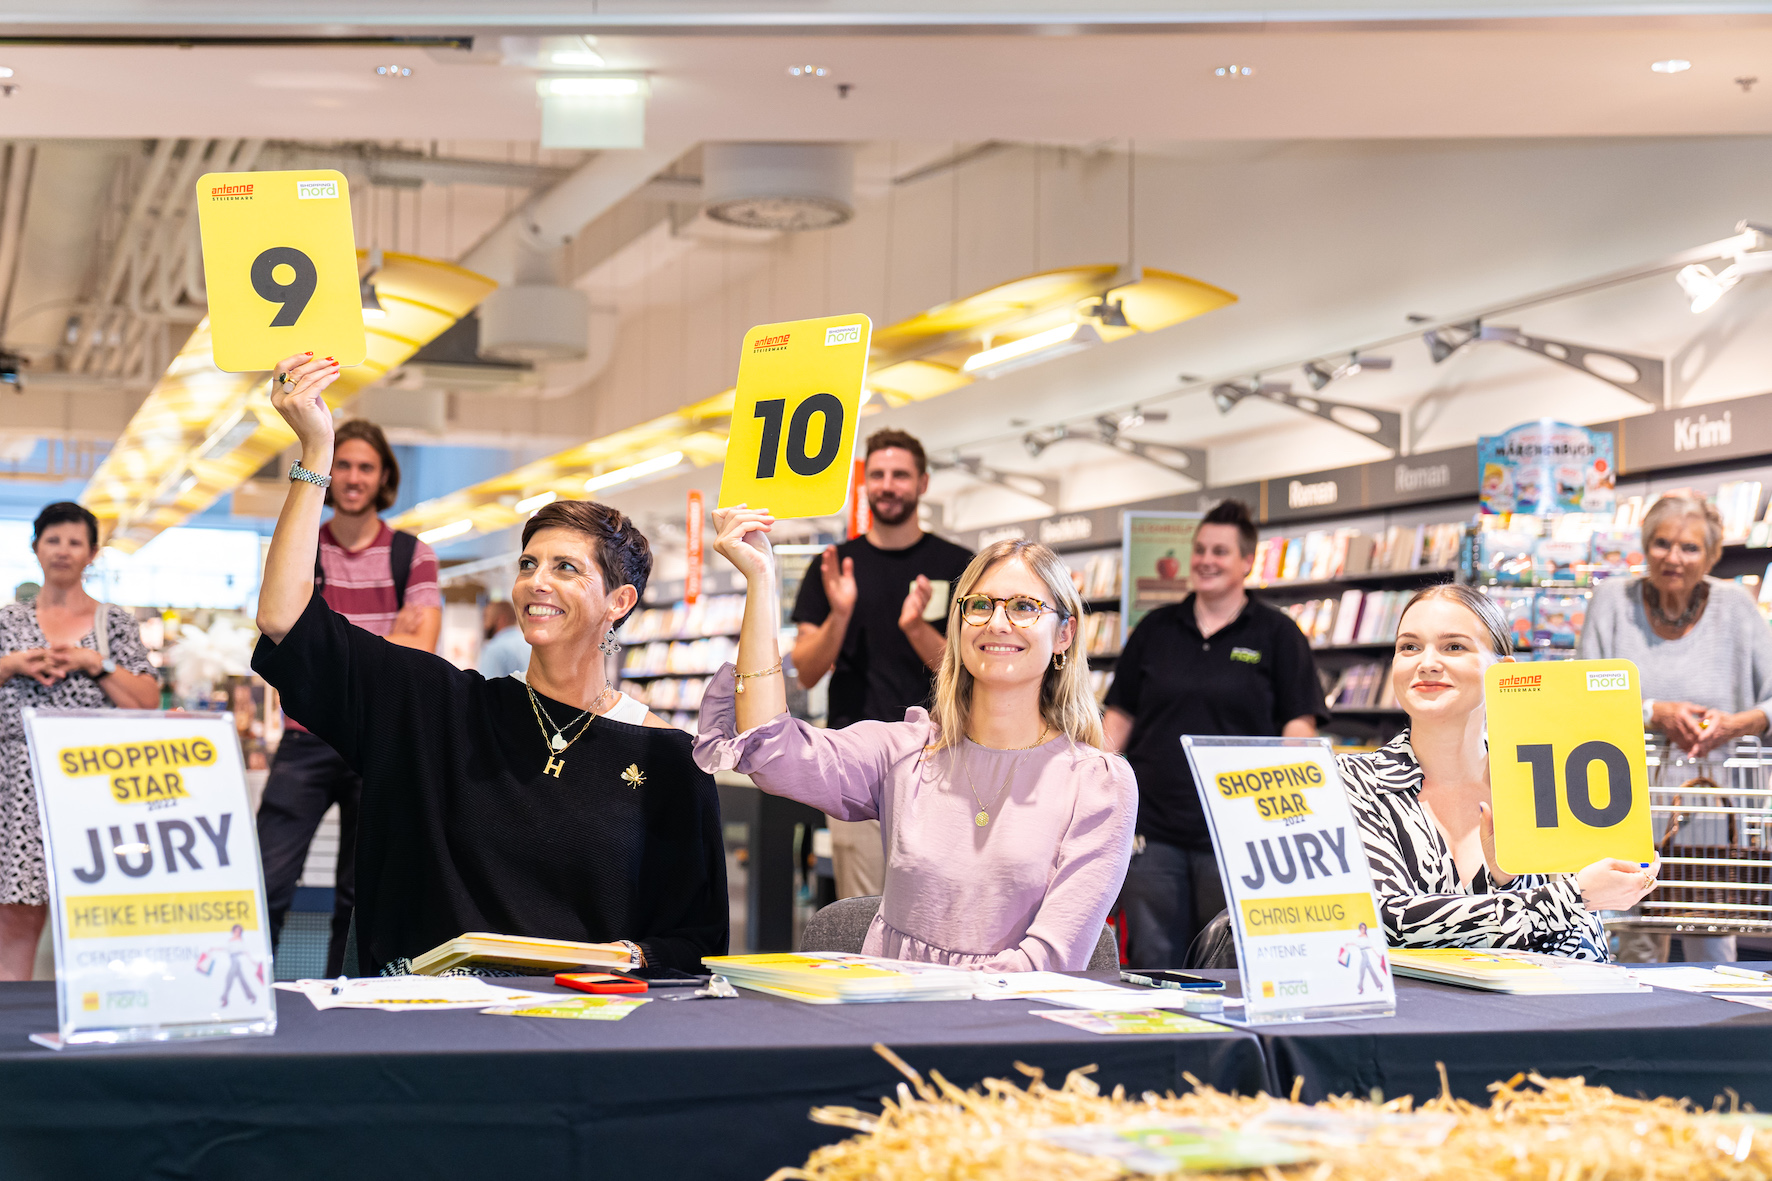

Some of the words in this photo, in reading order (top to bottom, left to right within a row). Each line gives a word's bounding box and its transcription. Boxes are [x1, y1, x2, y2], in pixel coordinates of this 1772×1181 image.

[212, 184, 254, 194] antenne
[301, 184, 336, 196] nord
[250, 246, 318, 328] 9
[754, 334, 790, 346] antenne
[828, 328, 859, 343] nord
[754, 393, 844, 479] 10
[1673, 410, 1732, 452] Krimi
[1395, 464, 1449, 493] Roman
[1288, 480, 1338, 509] Roman
[1499, 674, 1542, 686] antenne
[1590, 674, 1626, 688] nord
[62, 741, 212, 774] SHOPPING
[114, 773, 183, 799] STAR
[1218, 765, 1322, 796] SHOPPING
[1516, 740, 1633, 828] 10
[1258, 793, 1308, 817] STAR
[1282, 813, 1306, 827] 2022
[72, 812, 232, 884] JURY
[1240, 826, 1351, 890] JURY
[74, 904, 137, 927] HEIKE
[143, 900, 250, 924] HEINISSER
[1248, 906, 1300, 926] CHRISI
[1305, 904, 1346, 922] KLUG
[1257, 944, 1307, 958] ANTENNE
[1279, 980, 1308, 996] nord
